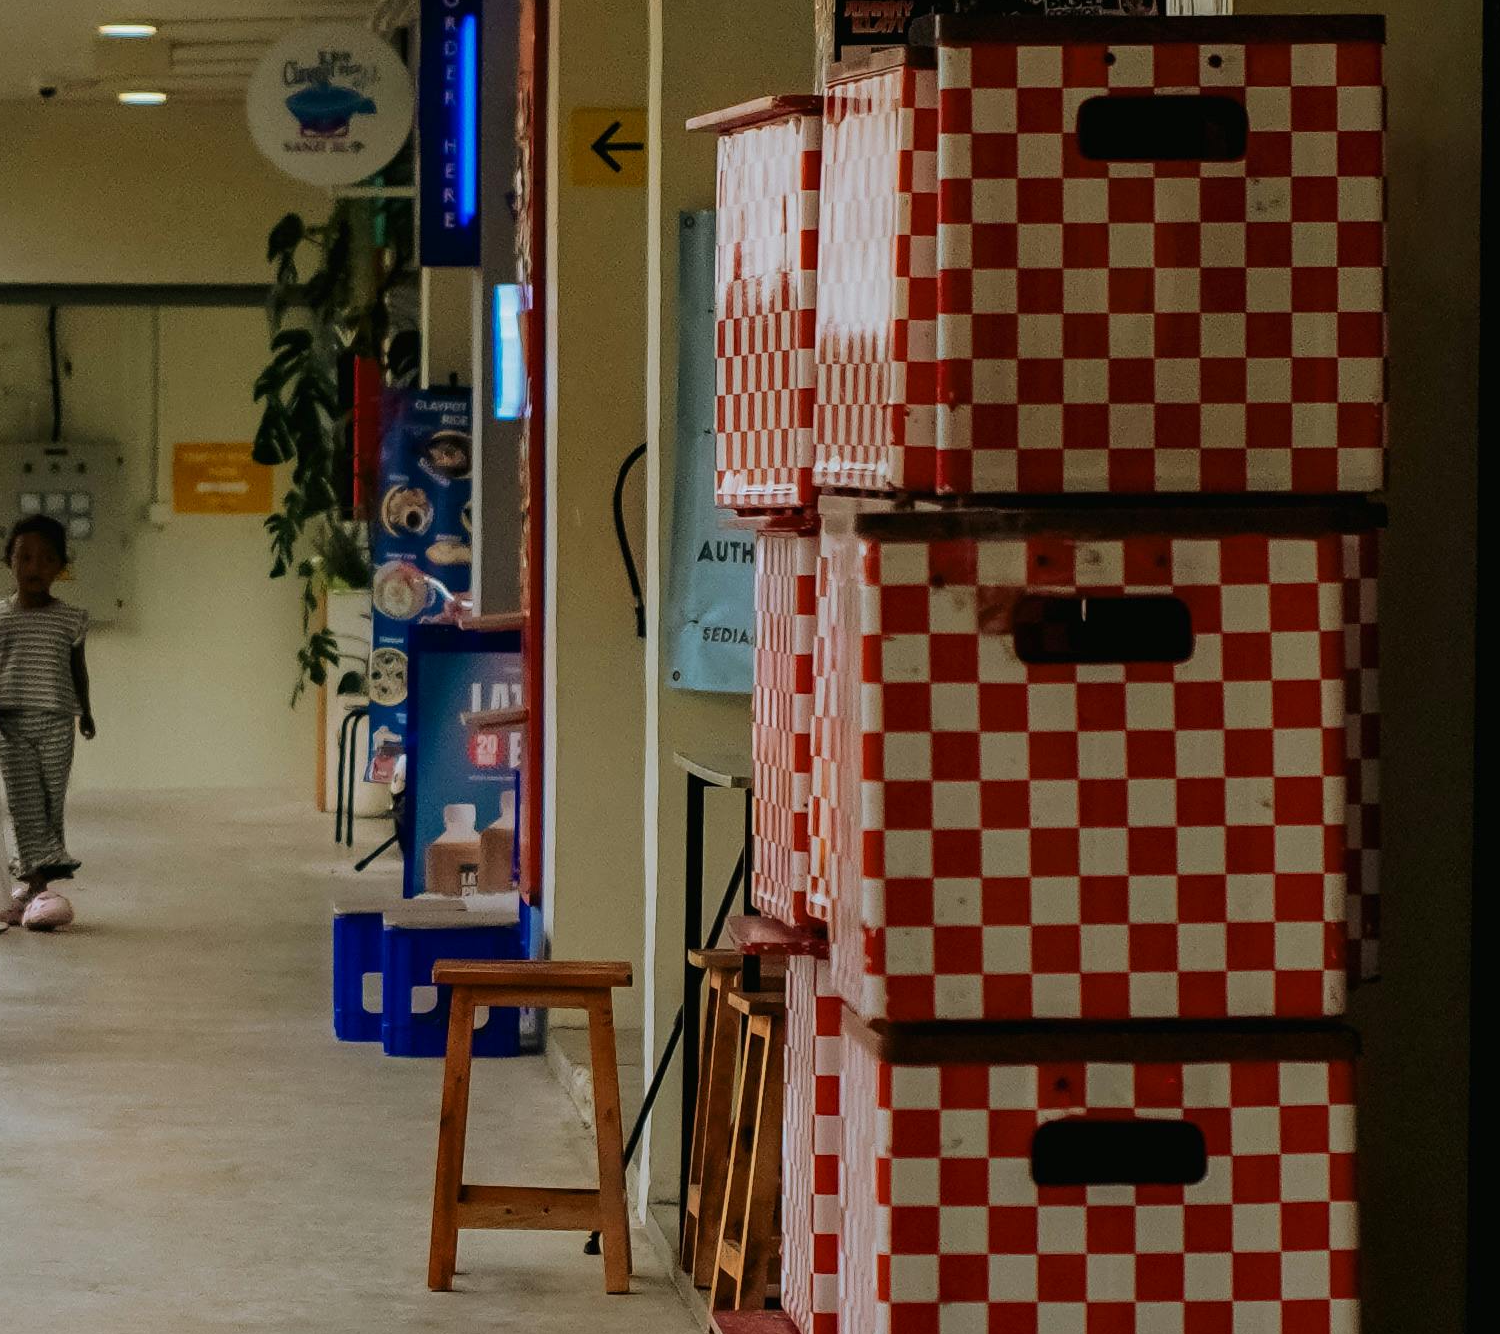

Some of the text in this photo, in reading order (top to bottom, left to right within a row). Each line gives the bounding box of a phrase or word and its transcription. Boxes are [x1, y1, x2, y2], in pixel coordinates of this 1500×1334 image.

[442, 138, 458, 229] HERE
[440, 413, 470, 427] RICE
[697, 540, 755, 564] AUTH
